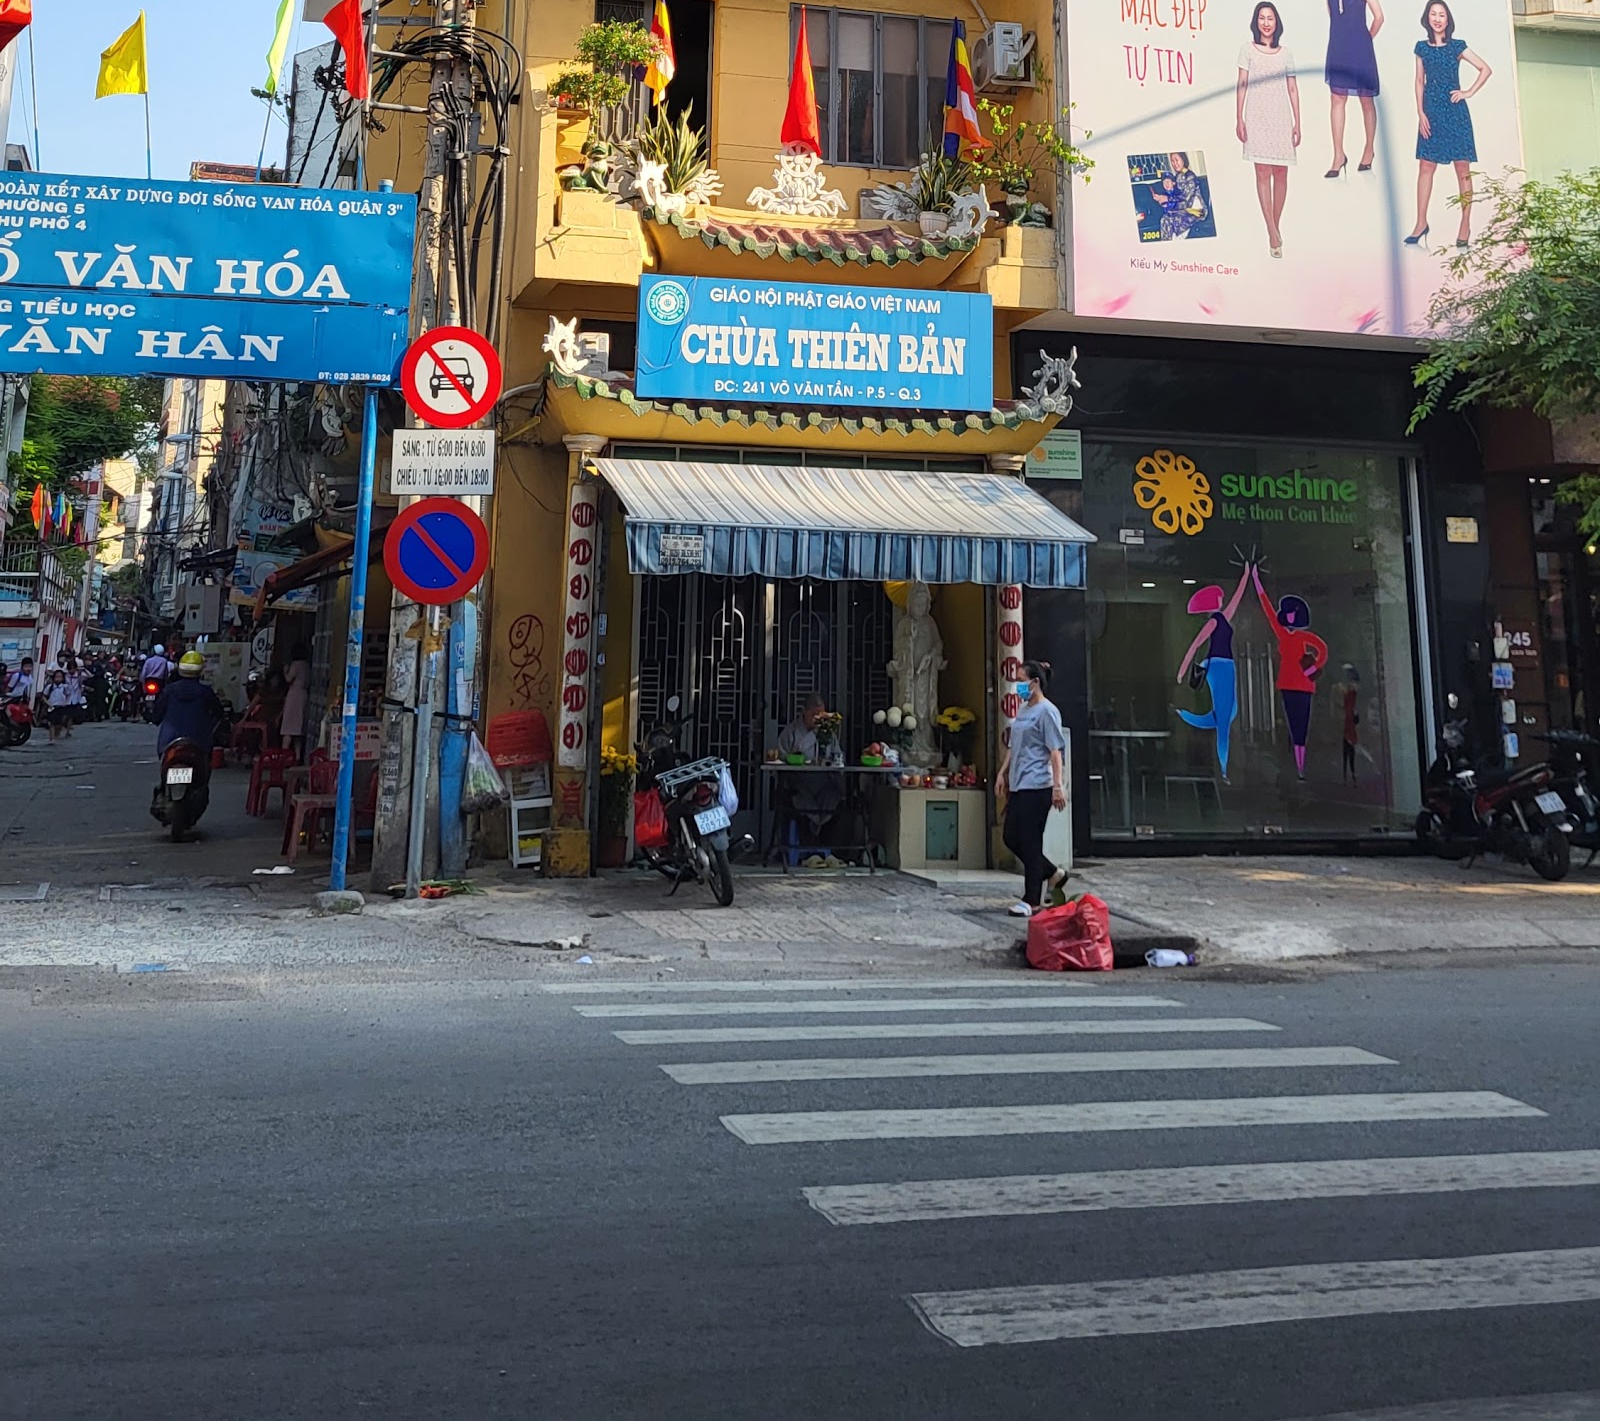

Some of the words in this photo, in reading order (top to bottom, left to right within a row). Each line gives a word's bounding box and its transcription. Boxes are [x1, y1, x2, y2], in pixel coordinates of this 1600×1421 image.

[1122, 44, 1151, 87] TỰ
[1153, 48, 1194, 86] TIN
[0, 179, 41, 197] OÀN
[45, 180, 81, 198] KẾT
[85, 184, 122, 201] XÂY
[126, 188, 174, 205] DỰNG
[213, 189, 258, 208] SỐNG
[299, 195, 335, 212] HÓA
[338, 199, 384, 216] QUẬN
[74, 203, 86, 215] 5
[29, 215, 72, 231] PHỐ
[75, 220, 87, 232] 4
[1142, 231, 1160, 240] 2004
[54, 243, 193, 292] VĂN
[213, 247, 351, 300] HÓA
[1153, 260, 1168, 273] My
[1170, 261, 1214, 274] Sunshine
[1216, 264, 1239, 276] Care
[21, 297, 78, 316] TIỂU
[85, 302, 137, 320] HỌC
[709, 285, 751, 304] GIÁO
[755, 290, 782, 307] HỘI
[785, 291, 823, 310] PHẬT
[826, 292, 867, 310] GIÁO
[870, 294, 902, 314] VIỆT
[905, 299, 941, 314] NAM
[135, 325, 284, 363] HÂN
[680, 316, 780, 368] CHÙA
[788, 321, 891, 372] THIÊN
[898, 322, 967, 376] BẢN
[334, 372, 349, 381] 028
[350, 373, 371, 381] 3839
[714, 380, 739, 393] ĐC:
[742, 382, 765, 394] 241
[769, 380, 791, 395] VÕ
[794, 381, 824, 397] VĂN
[827, 379, 854, 398] TẦN
[866, 389, 886, 399] P.5
[898, 387, 922, 401] Q.3
[402, 436, 421, 457] SÁNG
[426, 434, 437, 457] TỪ
[437, 439, 453, 457] 6:00
[454, 433, 469, 457] ĐẾN
[470, 440, 486, 457] 8:00
[423, 461, 433, 486] TỪ
[434, 468, 453, 486] 16:00
[454, 461, 469, 486] ĐẾN
[470, 468, 489, 486] 18:00
[1220, 468, 1358, 502] sunshine
[1221, 502, 1247, 525] Mẹ
[1249, 502, 1284, 522] thon
[1288, 505, 1317, 523] Con
